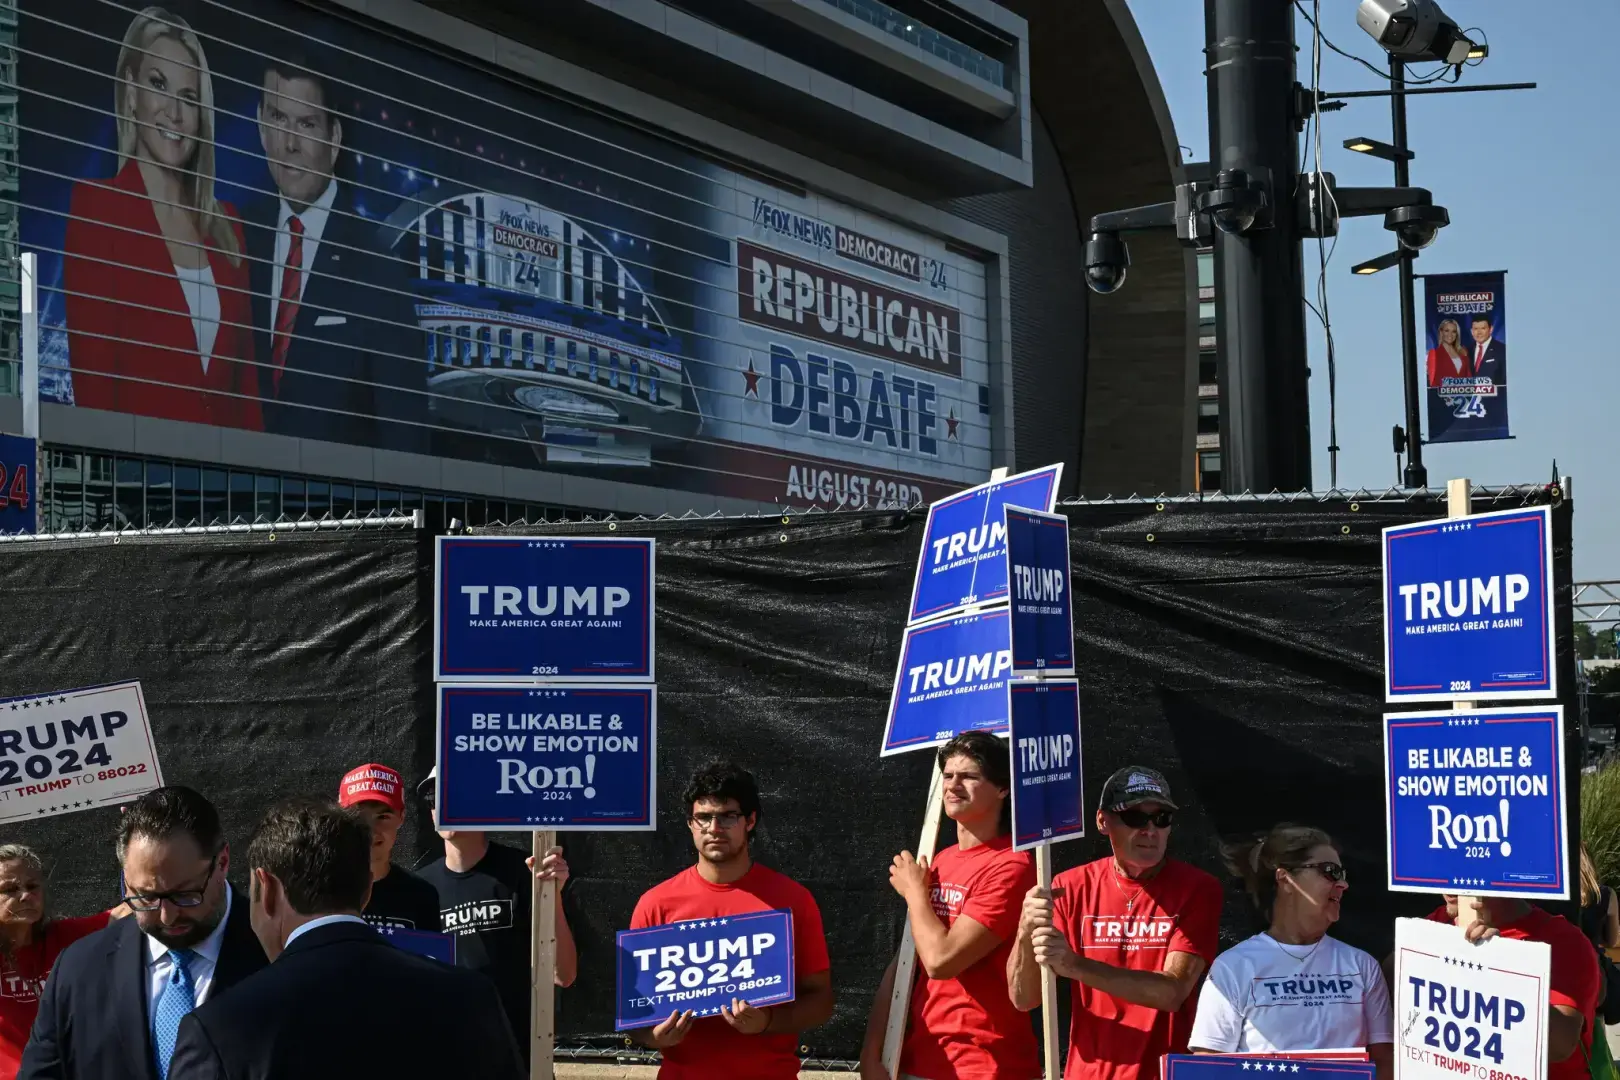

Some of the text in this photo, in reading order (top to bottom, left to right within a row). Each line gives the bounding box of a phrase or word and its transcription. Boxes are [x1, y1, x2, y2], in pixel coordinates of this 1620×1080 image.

[506, 214, 549, 237] FOX NEWS
[495, 229, 555, 257] DEMOCRACY
[763, 204, 792, 237] FOX
[793, 217, 832, 250] NEWS
[838, 231, 917, 276] DEMOCRACY
[515, 252, 540, 288] 24
[752, 256, 949, 364] REPUBLICAN
[1440, 293, 1489, 303] REPUBLICAN
[1443, 303, 1485, 313] DEBATE
[1440, 386, 1493, 394] DEMOCRACY
[1448, 377, 1490, 385] FOX NEWS
[769, 343, 938, 456] DEBATE
[1454, 396, 1483, 415] 24
[786, 466, 922, 511] AUGUST 23RD
[932, 518, 1008, 565] TRUM
[932, 563, 949, 575] MAKE
[949, 555, 977, 569] AMERICA
[978, 549, 1000, 561] GREAT
[1014, 564, 1064, 602] TRUMP
[460, 585, 630, 616] TRUMP
[1399, 573, 1530, 621] TRUMP
[469, 619, 622, 628] MAKE AMERICA GREAT AGAIN!
[1405, 618, 1523, 635] MAKE AMERICA GREAT AGAIN!
[532, 666, 559, 675] 2024
[908, 650, 1012, 694] TRUMP
[908, 681, 1004, 704] MAKE AMERICA GREAT AGAIN!
[1450, 680, 1471, 691] 2024
[0, 710, 128, 757] RUMP
[471, 713, 623, 730] BE LIKABLE &
[454, 735, 638, 752] SHOW EMOTION
[935, 730, 953, 740] 2024
[0, 742, 112, 787] 2024
[1018, 734, 1073, 773] TRUMP
[1408, 745, 1533, 769] BE LIKABLE &
[15, 778, 72, 797] TRUMP
[73, 773, 95, 786] TO
[98, 763, 147, 781] 88022
[344, 769, 398, 785] MAKE AMERICA
[347, 781, 394, 795] GREAT AGAIN
[496, 754, 596, 799] Ron!
[1398, 775, 1548, 797] SHOW EMOTION
[542, 791, 572, 801] 2024
[1428, 798, 1512, 857] Ron!
[1465, 847, 1491, 859] 2024
[931, 887, 962, 905] RUMP
[440, 905, 502, 927] RUMP
[460, 928, 476, 936] 2024
[1093, 921, 1171, 937] TRUMP
[633, 933, 776, 971] TRUMP
[655, 958, 755, 992] 2024
[1264, 979, 1353, 995] TRUMP
[629, 975, 782, 1008] TEXT TRUMP TO 88022
[1409, 976, 1525, 1031] TRUMP
[1424, 1016, 1504, 1064] 2024
[1405, 1045, 1528, 1080] TEXT TRUMP TO 880
